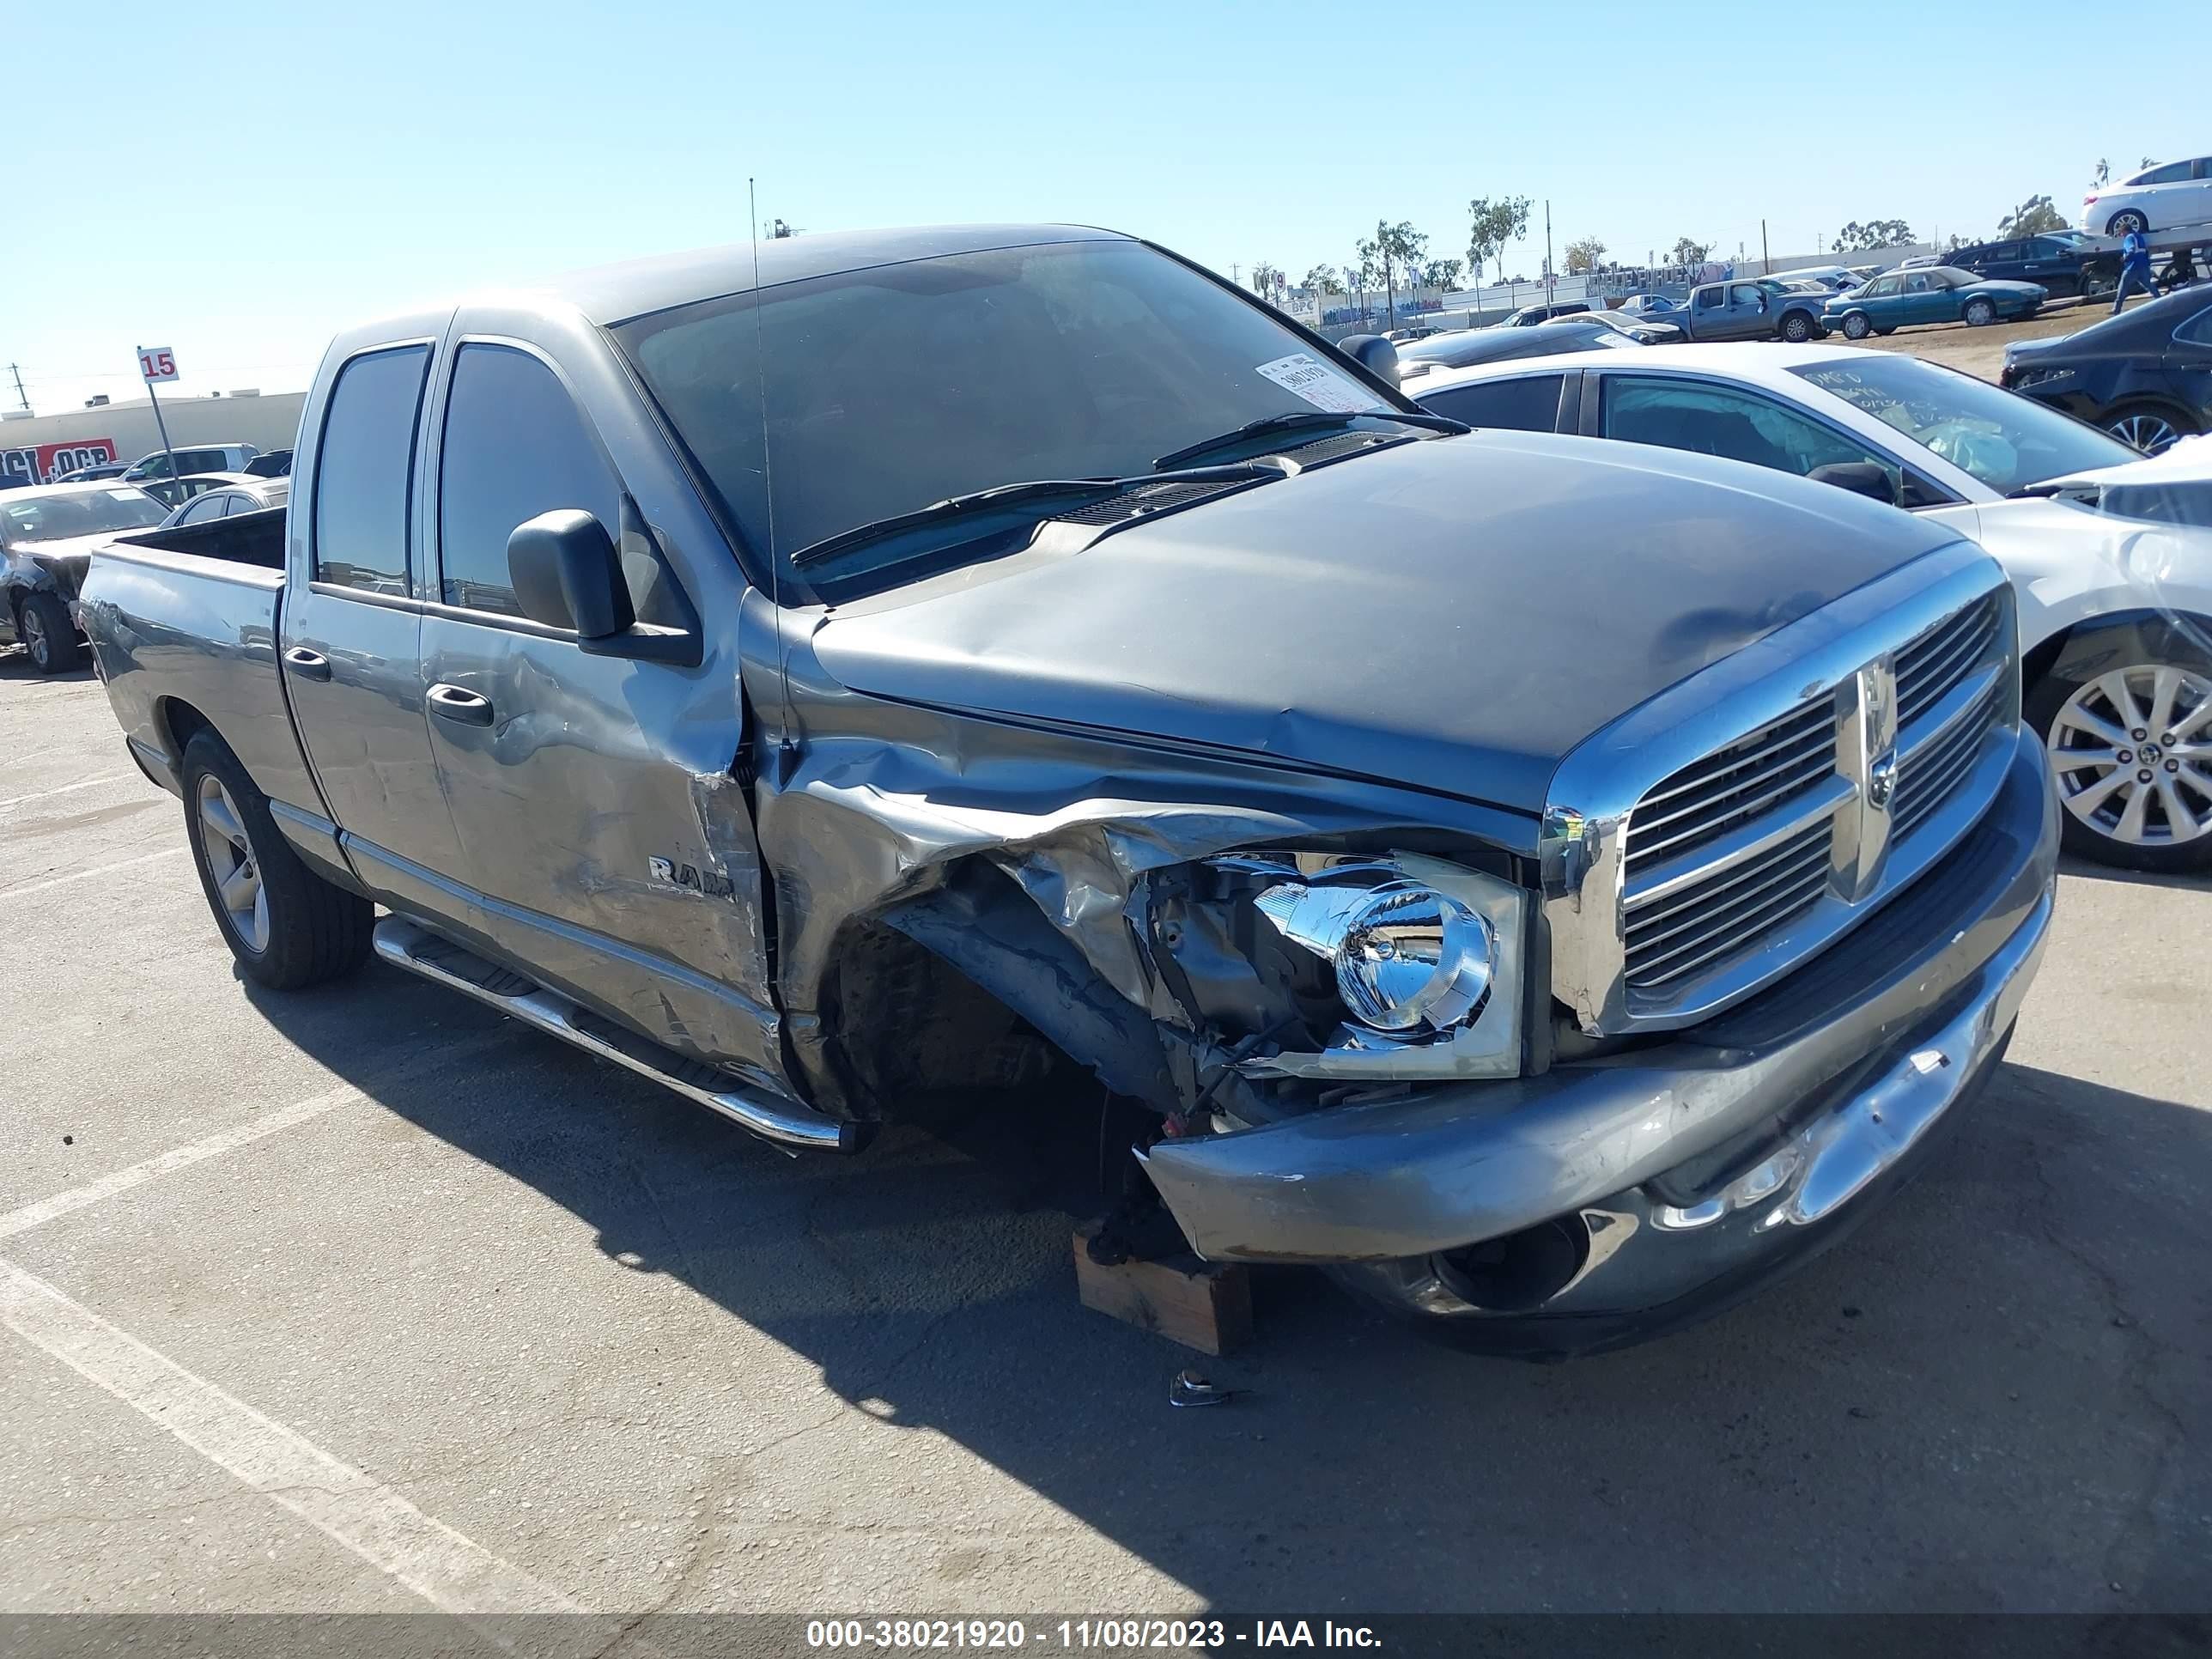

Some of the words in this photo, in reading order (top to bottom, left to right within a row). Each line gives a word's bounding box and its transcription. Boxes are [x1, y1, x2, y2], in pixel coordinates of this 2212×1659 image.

[1412, 268, 1418, 281] 7
[1477, 266, 1483, 276] 6
[1277, 274, 1283, 289] 9
[1350, 272, 1355, 285] 8
[1536, 279, 1542, 288] G
[1550, 277, 1557, 286] H
[141, 353, 175, 377] 15
